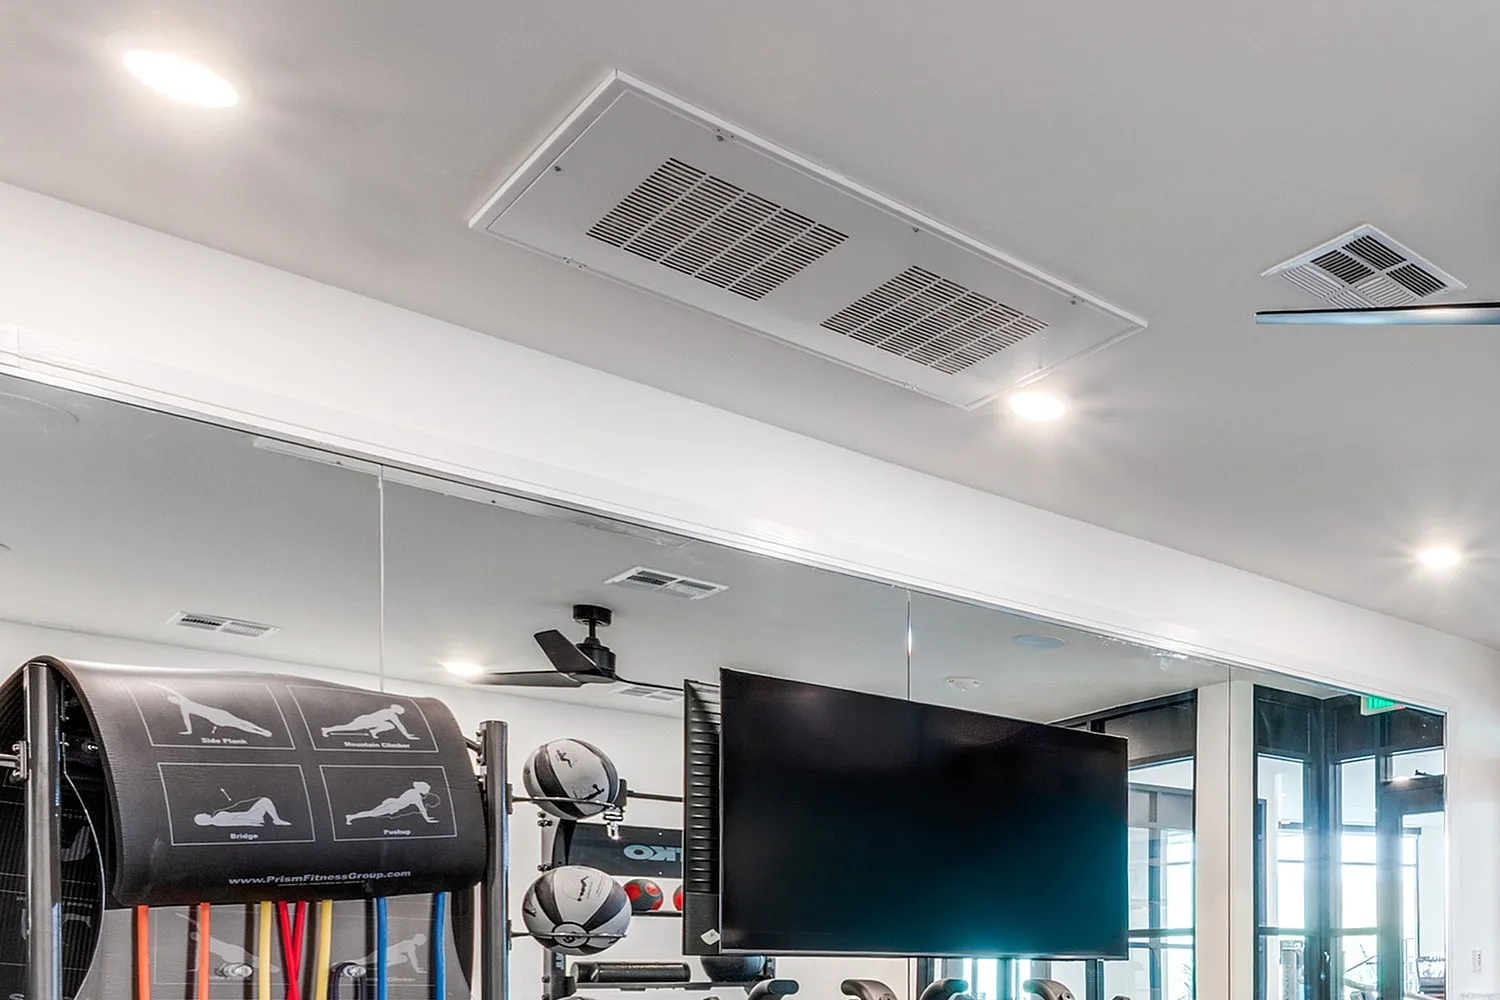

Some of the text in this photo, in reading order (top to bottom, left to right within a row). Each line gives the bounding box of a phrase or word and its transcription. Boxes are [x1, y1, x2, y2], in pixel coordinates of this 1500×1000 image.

[201, 737, 221, 745] Side
[383, 828, 411, 836] Pushup
[230, 832, 258, 841] Bridge
[228, 870, 411, 886] www.PrismFitnessGroup.com
